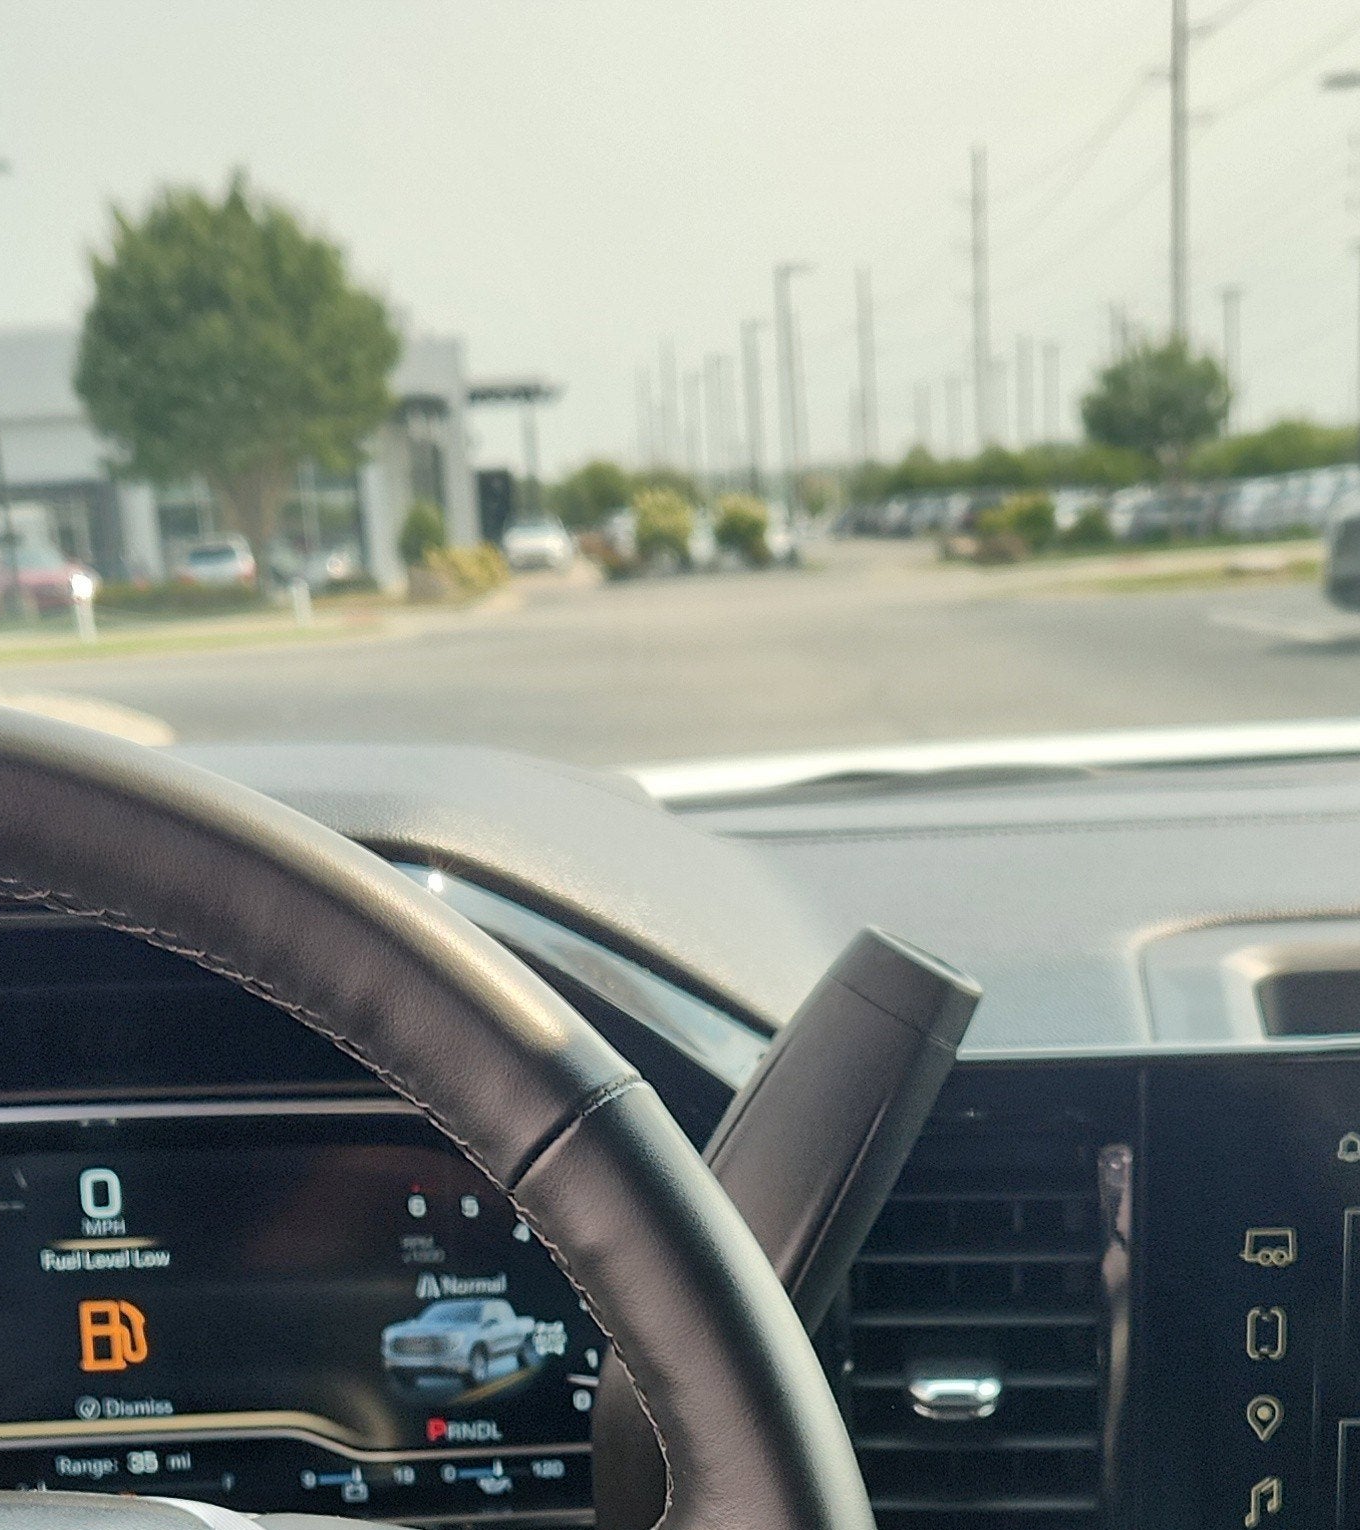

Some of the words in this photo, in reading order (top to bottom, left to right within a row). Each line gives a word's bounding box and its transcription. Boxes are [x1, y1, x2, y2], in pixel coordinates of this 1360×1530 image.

[80, 1168, 122, 1219] 0
[81, 1217, 126, 1236] MPH
[40, 1249, 81, 1271] Fuel
[82, 1249, 130, 1270] Level
[131, 1249, 171, 1268] Low
[441, 1272, 507, 1295] Normal
[102, 1397, 174, 1418] Dismiss
[55, 1454, 118, 1480] Range:
[165, 1451, 191, 1472] mi
